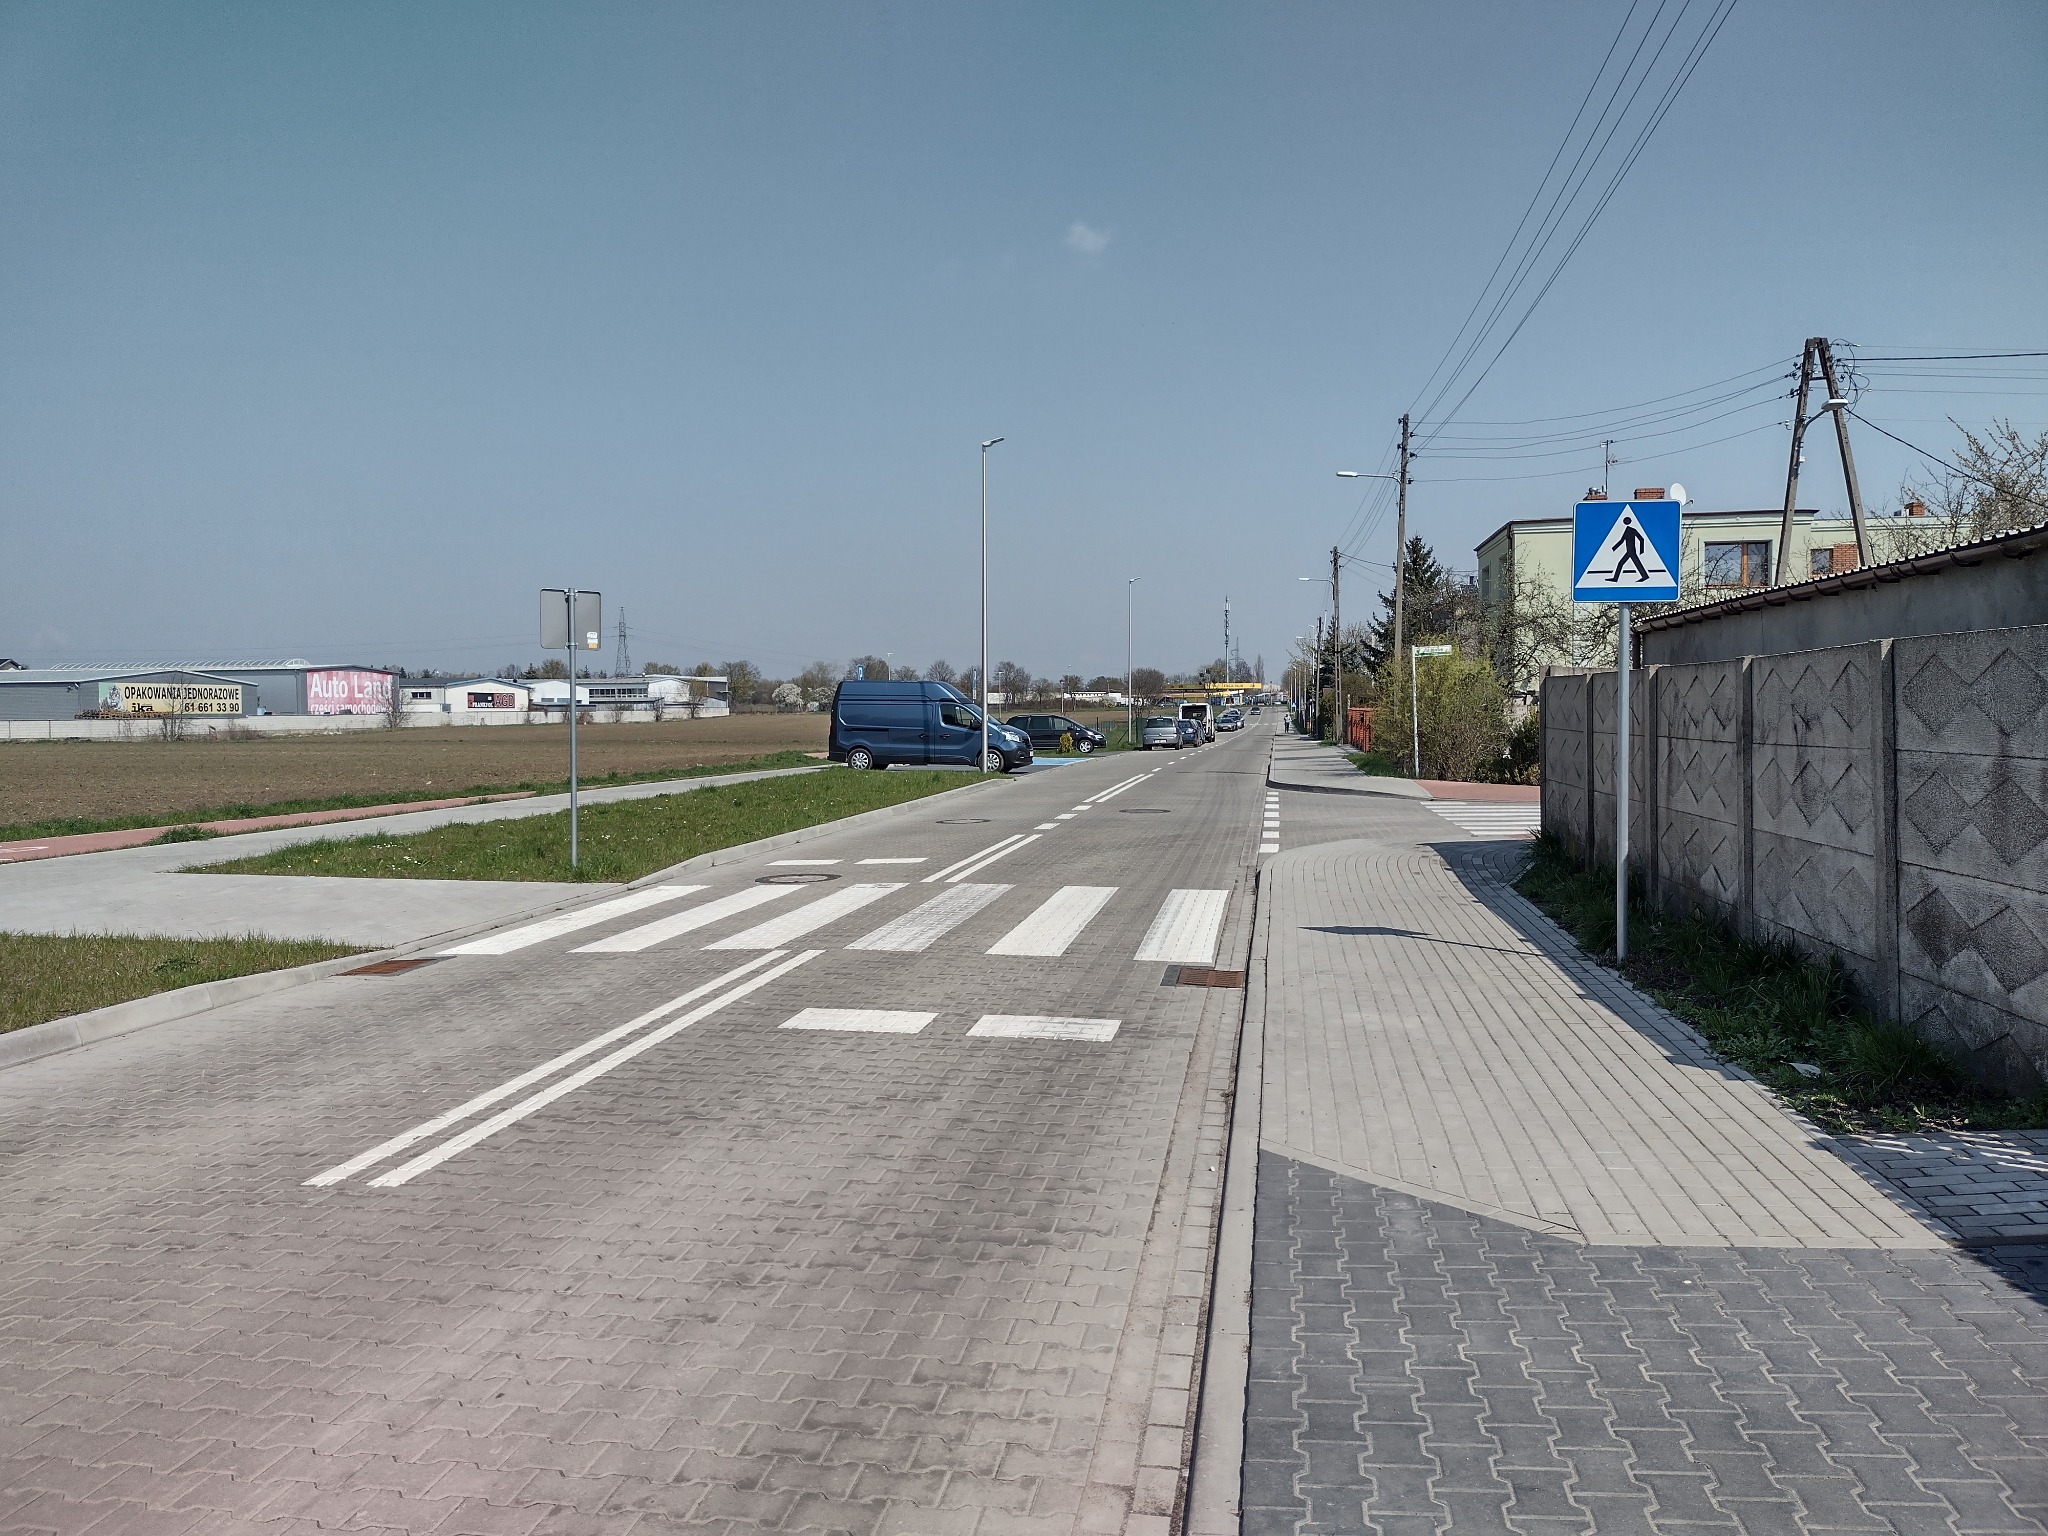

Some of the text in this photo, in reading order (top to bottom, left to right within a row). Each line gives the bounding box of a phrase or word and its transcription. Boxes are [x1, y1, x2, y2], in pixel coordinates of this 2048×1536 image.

[310, 673, 392, 698] Auto Land
[124, 686, 239, 700] OPAKOWANIA JEDNORAZOWE
[494, 694, 514, 707] AGD
[131, 702, 154, 713] ika
[184, 702, 240, 713] 61 661 33 90
